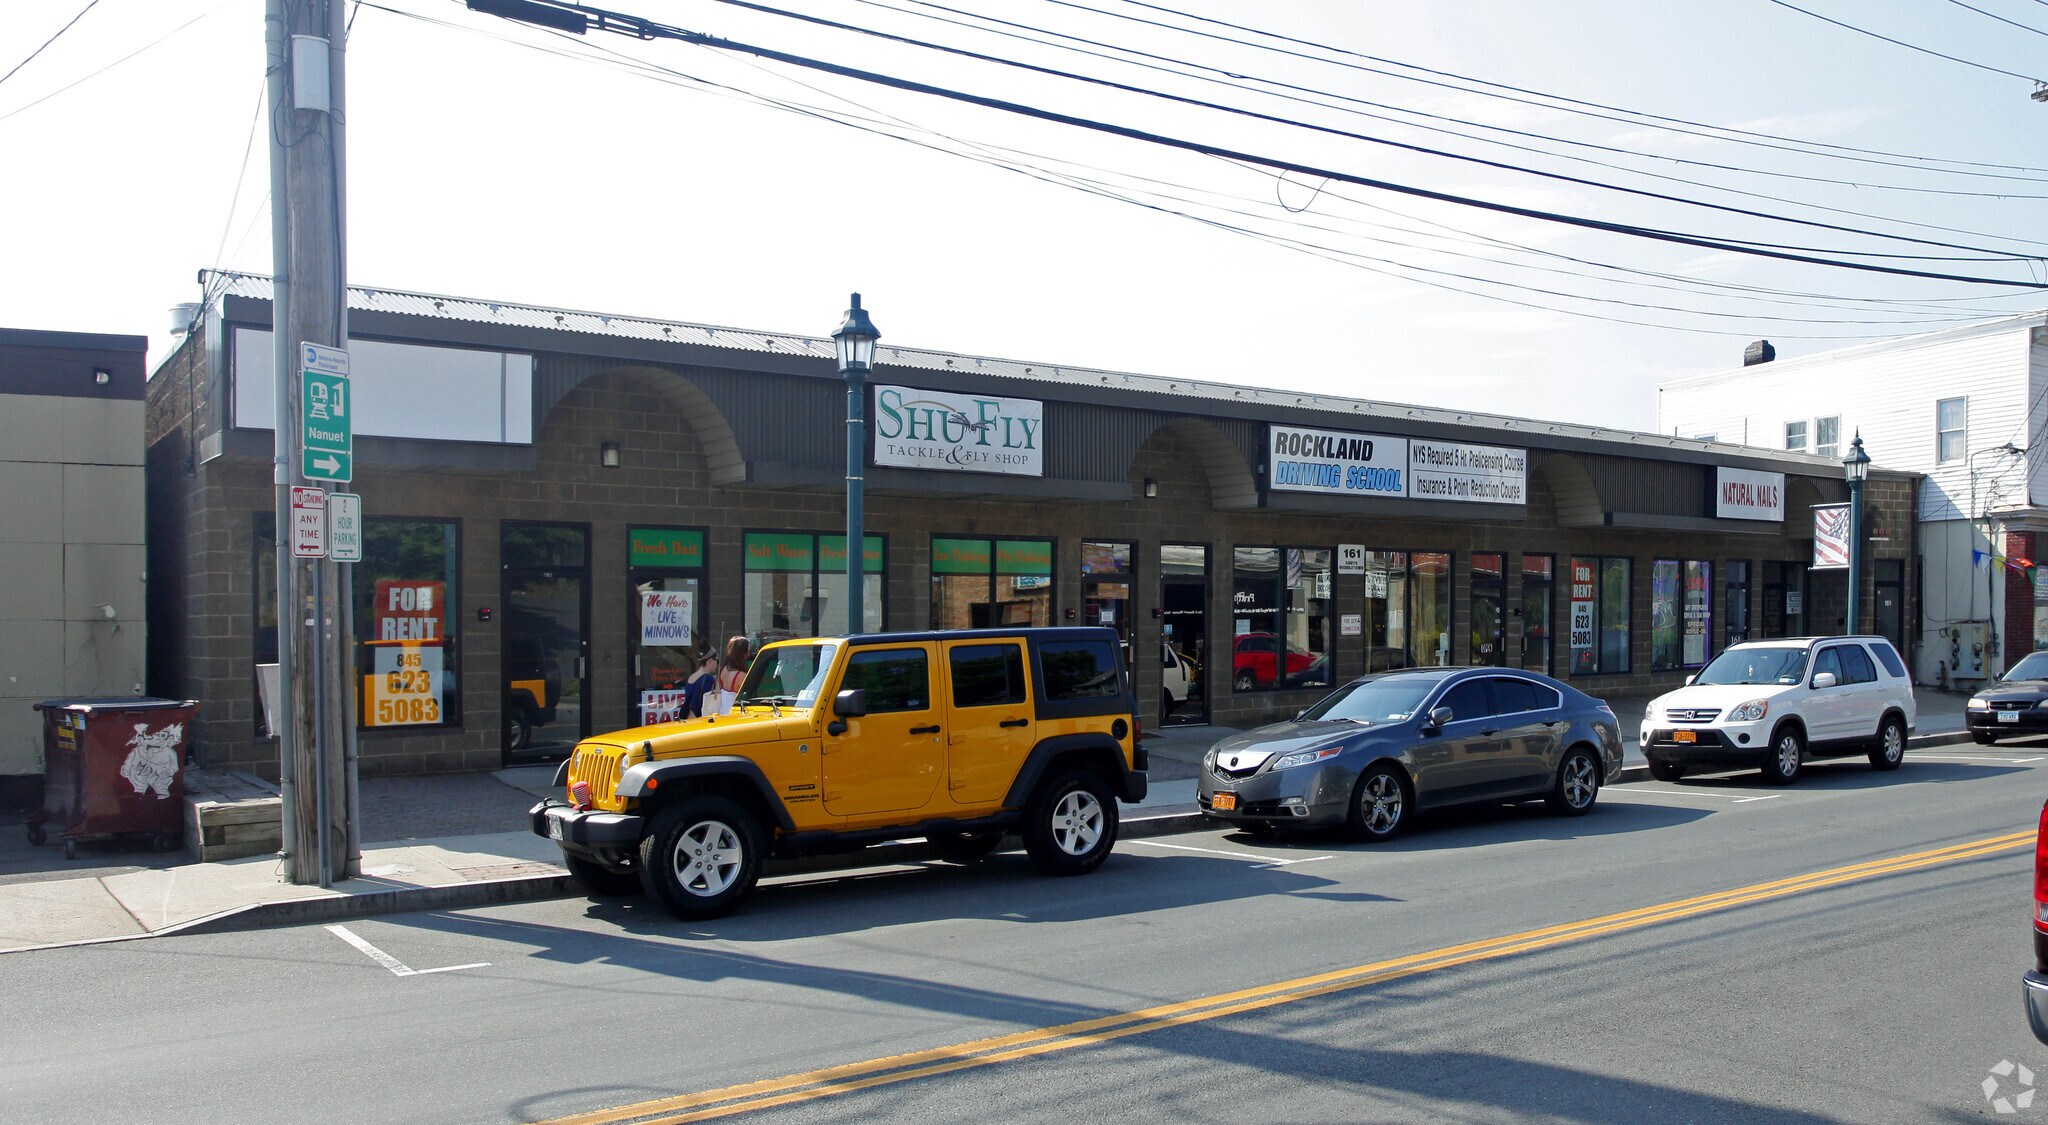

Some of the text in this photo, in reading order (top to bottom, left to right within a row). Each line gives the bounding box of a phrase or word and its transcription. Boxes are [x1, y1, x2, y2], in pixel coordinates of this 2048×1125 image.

[308, 427, 344, 442] Nanuet
[1275, 432, 1374, 461] ROCKLAND
[887, 444, 1028, 466] TACKLE & FLY SHOP
[1413, 445, 1426, 464] NYS
[1427, 446, 1453, 468] Required
[1454, 449, 1459, 467] 5
[1469, 450, 1503, 473] Prelicensing
[1504, 453, 1524, 471] Course
[1275, 461, 1402, 491] DRIVING SCHOOL
[1416, 475, 1520, 499] Insurance & Point Reduction Course
[294, 491, 322, 505] NO STANDING
[1723, 482, 1777, 508] NATURAL NAILS
[343, 499, 347, 513] 2
[300, 515, 318, 523] ANY
[338, 517, 352, 529] HOUR
[300, 530, 319, 539] TIME
[334, 533, 356, 545] PARKING
[633, 540, 698, 555] Fresh Bait
[749, 544, 810, 559] Salt Water
[1344, 549, 1361, 558] 161
[953, 549, 989, 565] Fishing
[1016, 550, 1051, 565] Fishing
[1575, 567, 1590, 581] FOR
[1573, 585, 1593, 598] RENT
[389, 587, 433, 612] FOR
[647, 594, 688, 608] We Have
[657, 610, 677, 624] LIVE
[1575, 615, 1590, 629] 623
[382, 617, 438, 641] RENT
[644, 624, 690, 638] MINNOWS
[1572, 631, 1591, 645] 5083
[396, 653, 421, 667] 845
[387, 670, 430, 694] 623
[647, 693, 685, 709] LIVE
[379, 698, 439, 723] 5083
[645, 711, 680, 726] BAI
